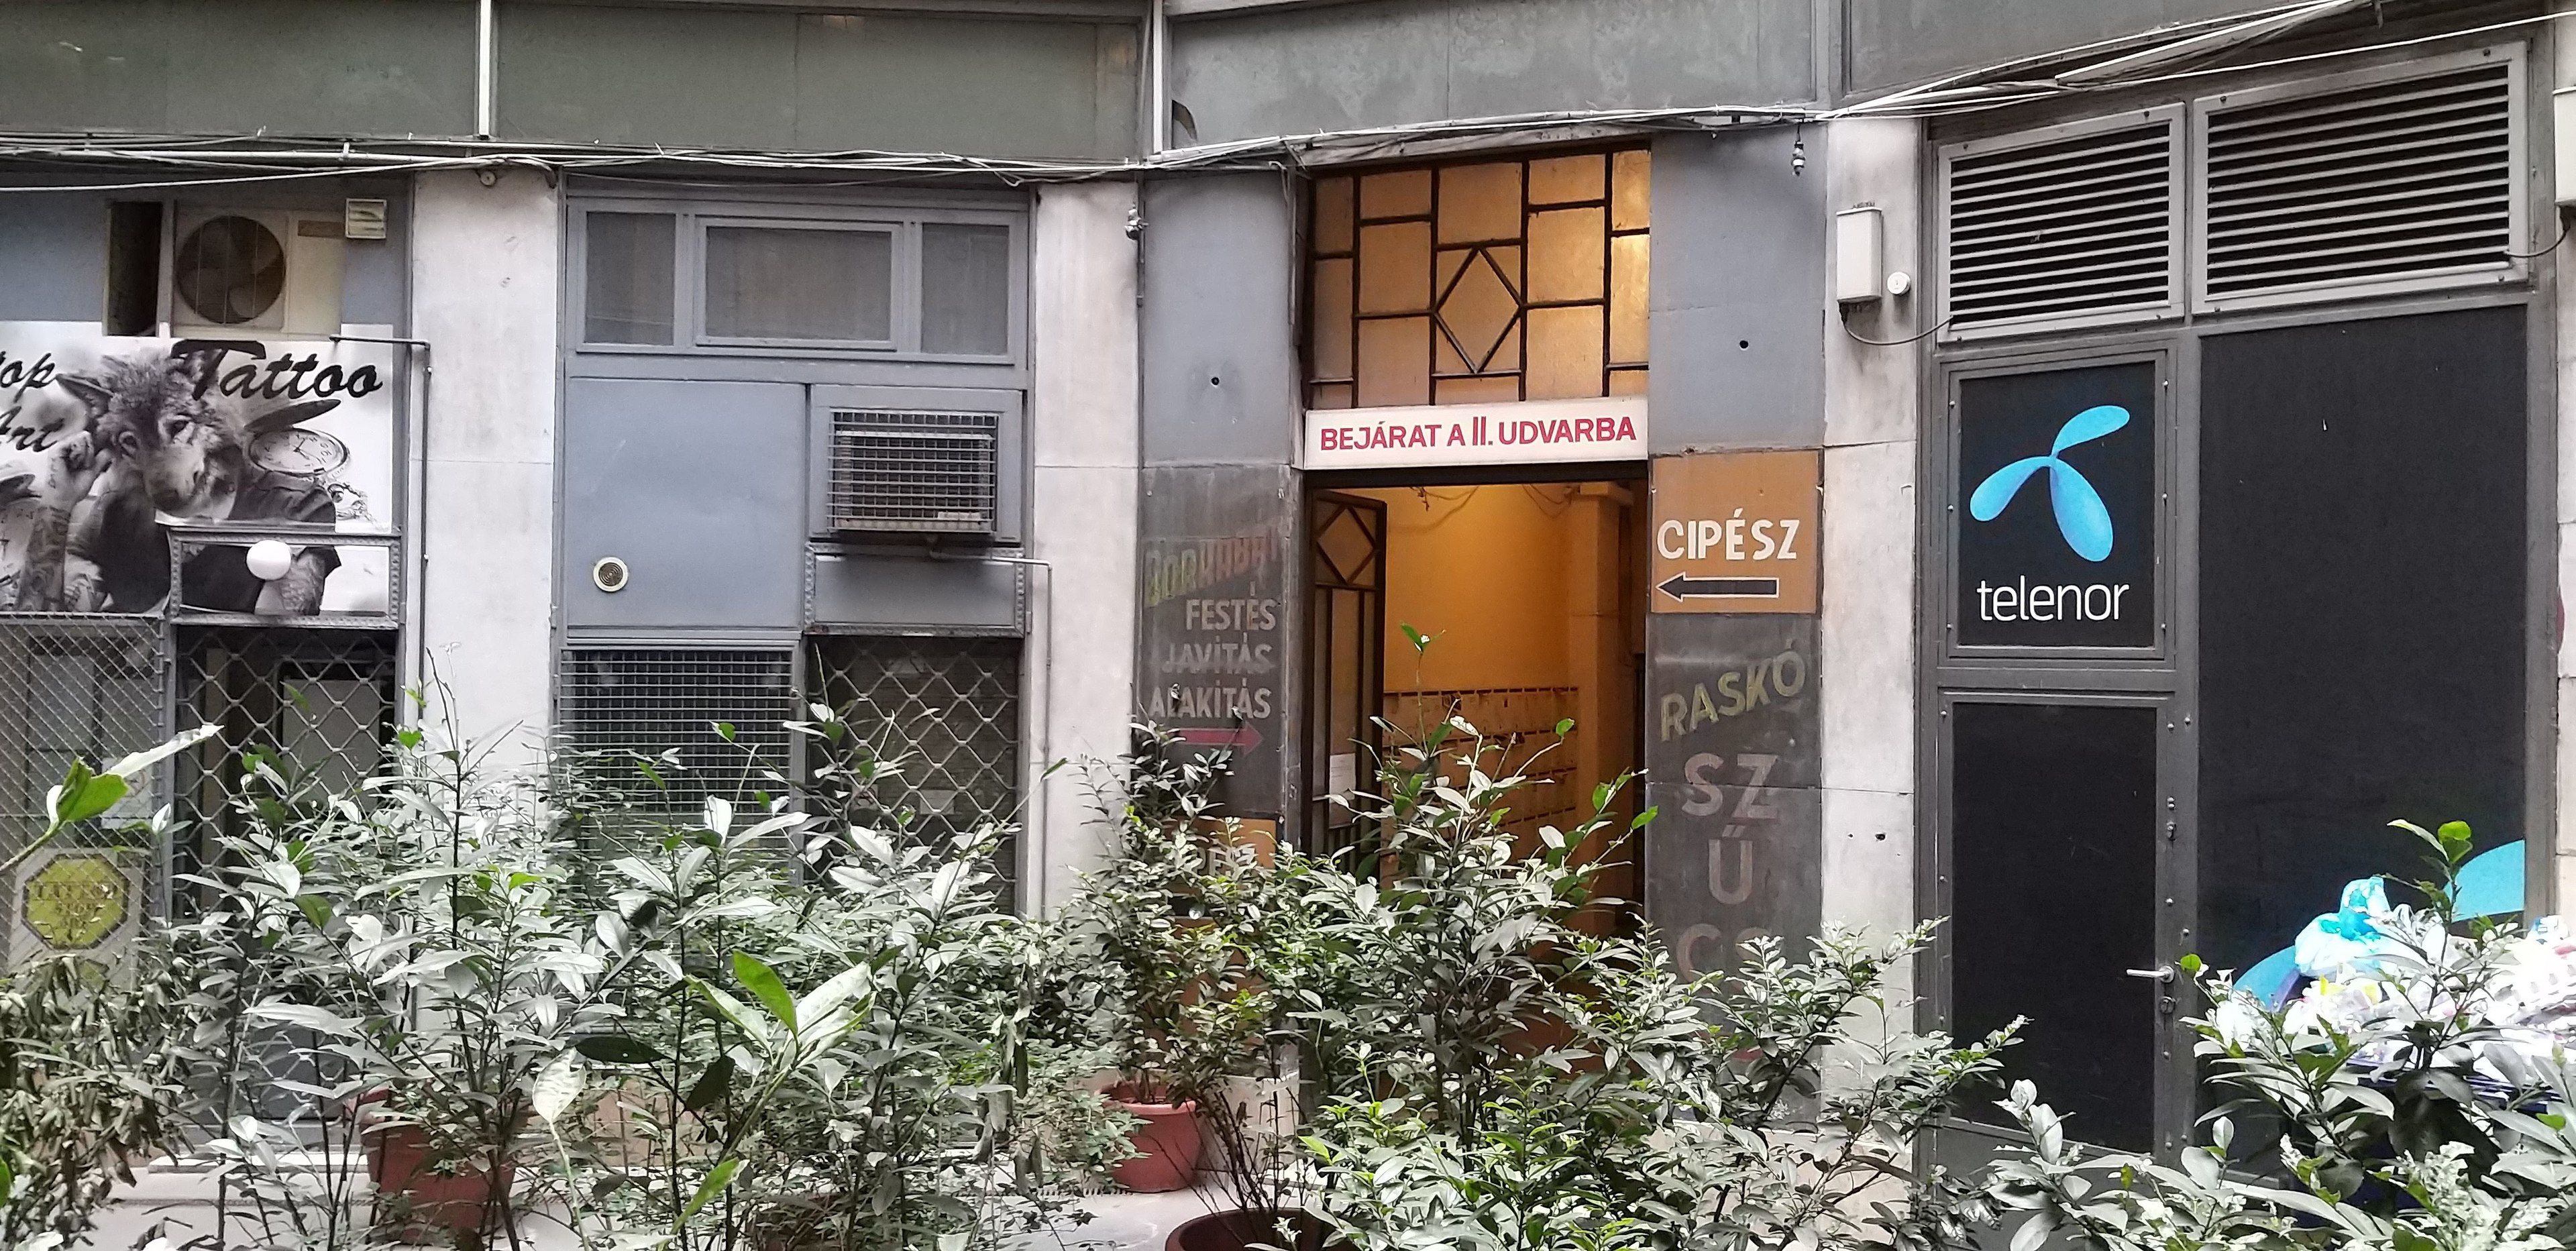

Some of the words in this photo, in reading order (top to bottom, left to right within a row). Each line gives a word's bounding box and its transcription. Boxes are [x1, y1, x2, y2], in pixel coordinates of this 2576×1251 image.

[0, 349, 56, 403] op
[171, 339, 383, 399] Tattoo
[1320, 421, 1442, 451] BEJÁRAT
[1447, 424, 1466, 446] A
[1472, 417, 1493, 446] II.
[1499, 416, 1637, 445] UDVARBA
[1657, 508, 1800, 561] CIPÉSZ
[1186, 581, 1277, 631] FESTÉS
[1976, 575, 2130, 621] telenor
[1162, 632, 1273, 674] JAVÍTÁS
[1660, 638, 1806, 742] RASKÓ
[1681, 753, 1779, 819] SZ
